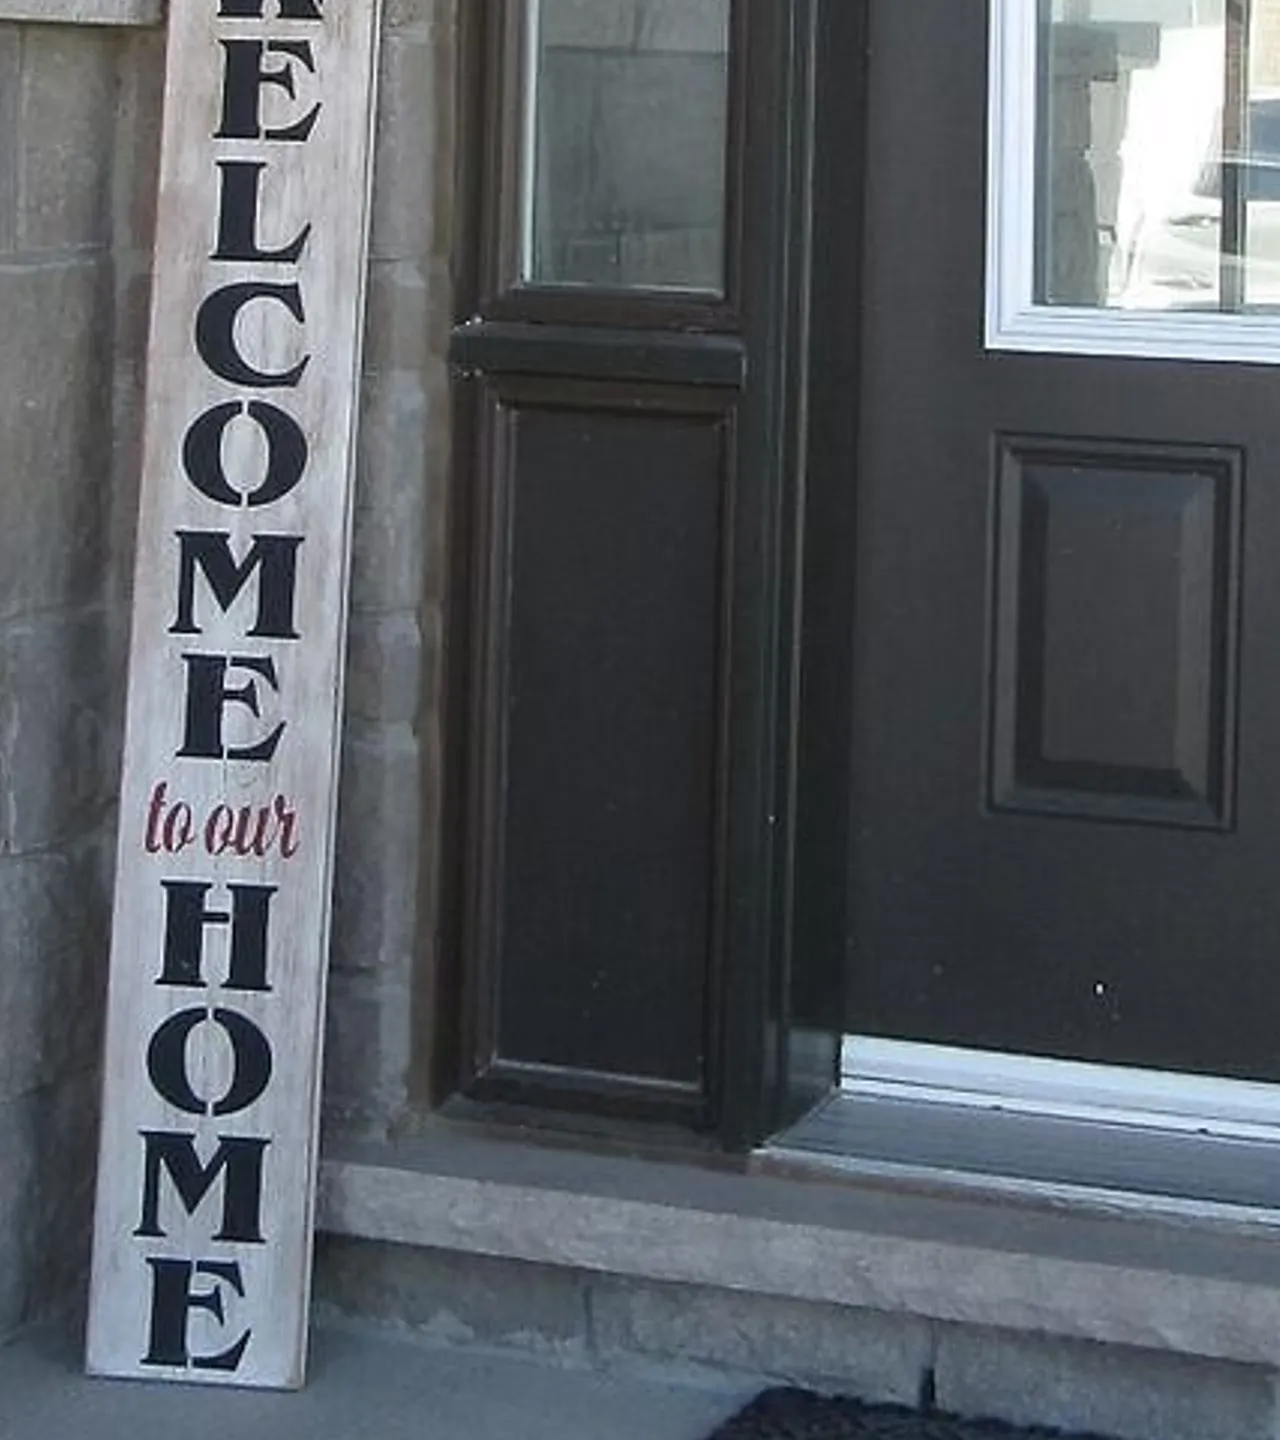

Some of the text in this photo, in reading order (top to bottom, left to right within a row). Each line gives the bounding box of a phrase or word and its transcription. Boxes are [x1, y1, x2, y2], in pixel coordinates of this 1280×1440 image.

[144, 780, 301, 859] to our
[132, 879, 279, 1371] HOME
